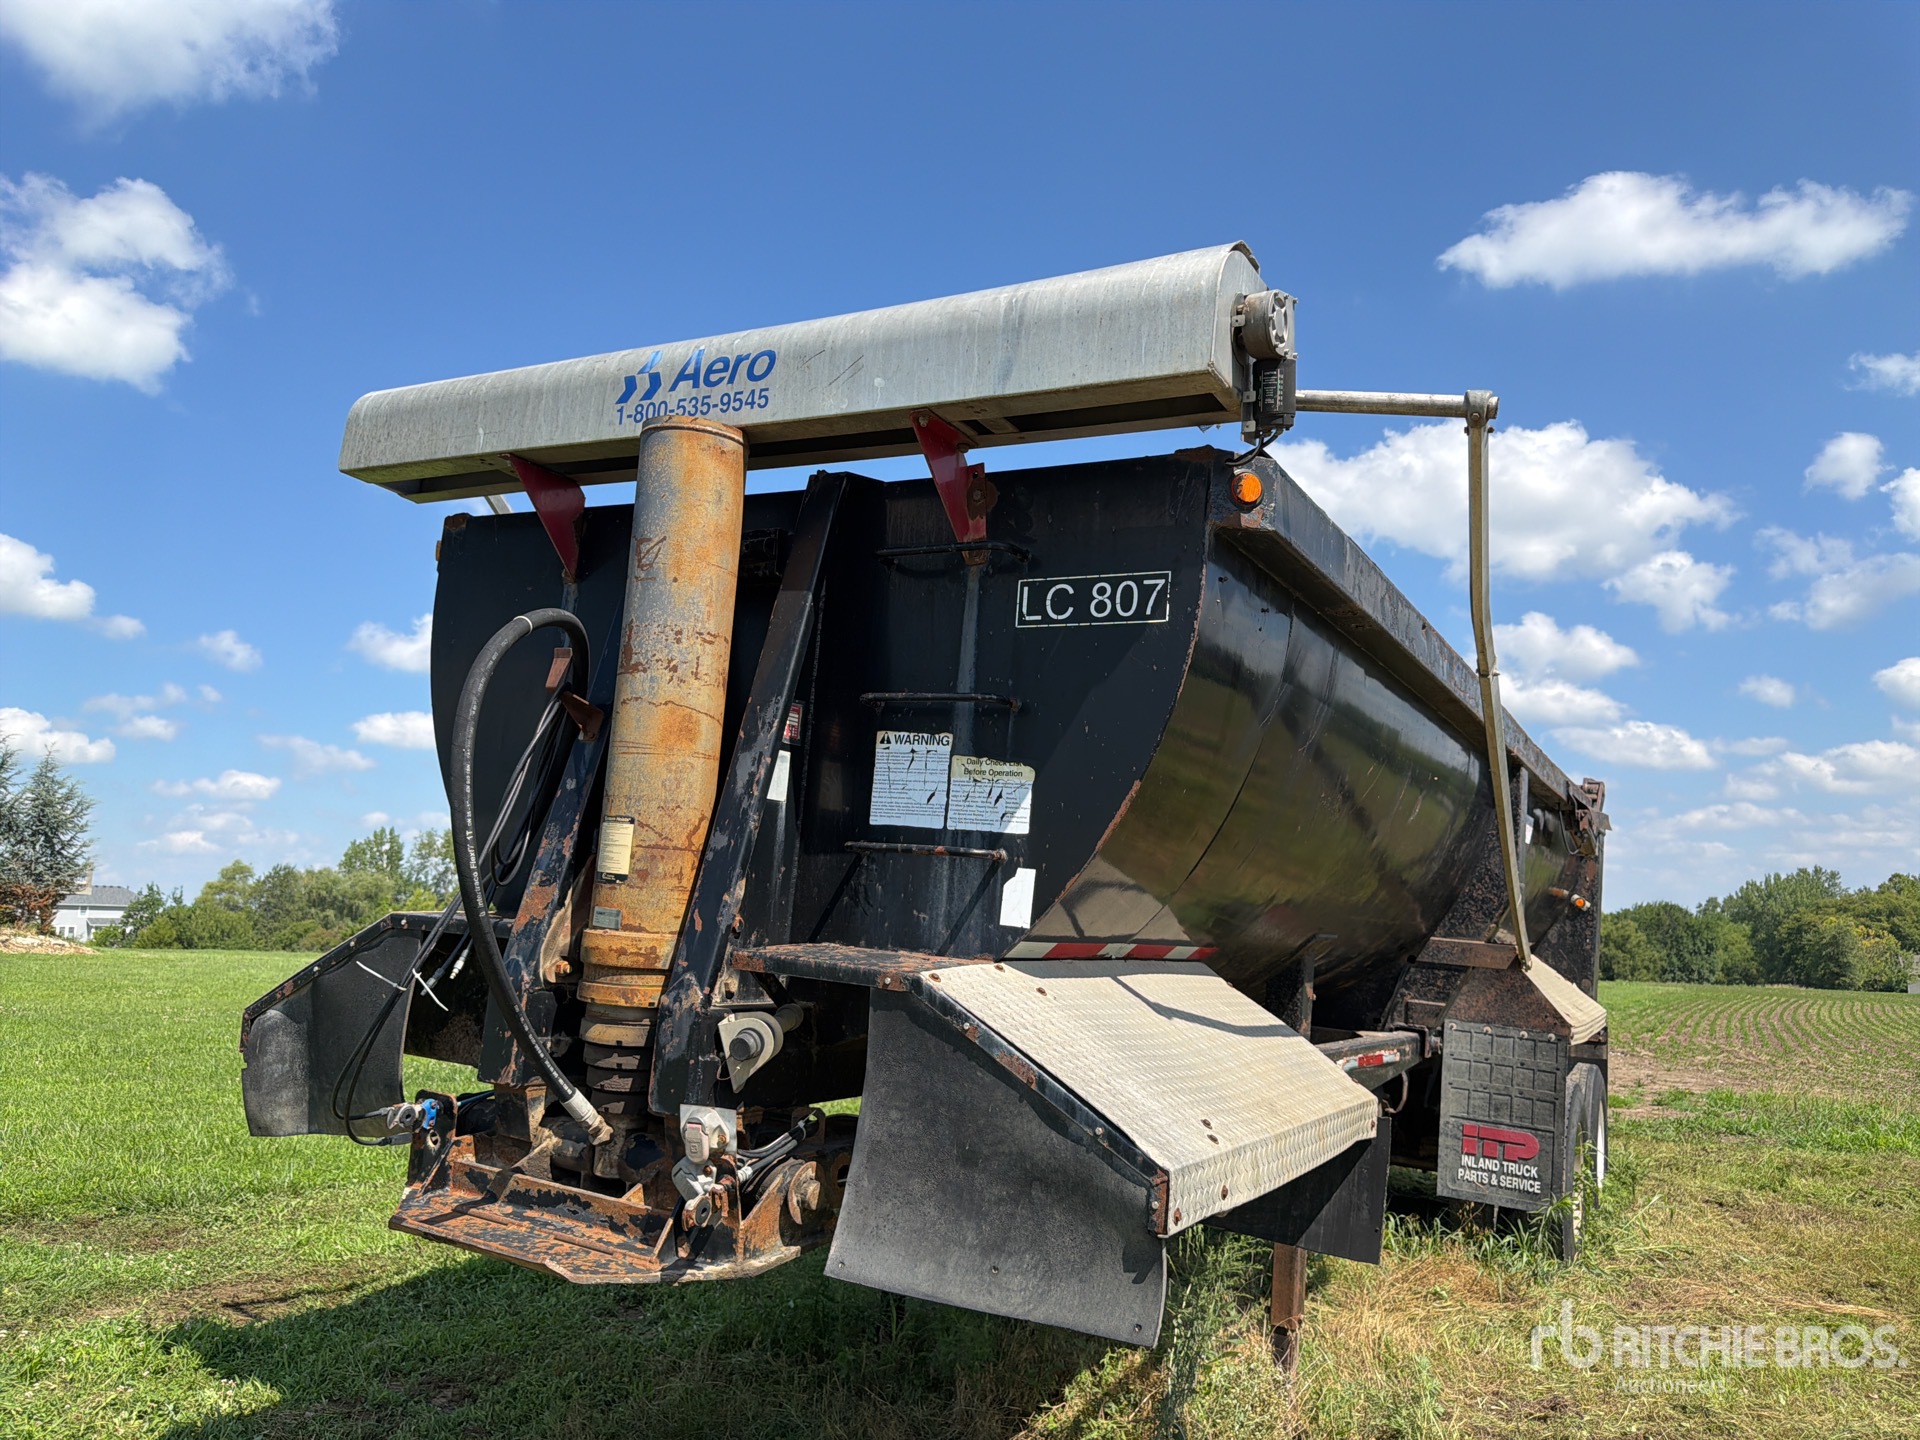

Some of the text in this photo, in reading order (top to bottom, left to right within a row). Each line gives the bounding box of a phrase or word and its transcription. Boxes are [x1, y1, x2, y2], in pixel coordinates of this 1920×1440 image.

[668, 347, 777, 392] Aero
[616, 387, 770, 426] 1-800-535-9545
[1022, 578, 1166, 621] LC 807
[894, 734, 950, 746] WARNING
[963, 768, 1023, 777] Before Operation
[966, 758, 983, 768] Daily
[1461, 1154, 1539, 1179] INLAND TRUCK
[1457, 1168, 1542, 1194] PARTS & SERVICE
